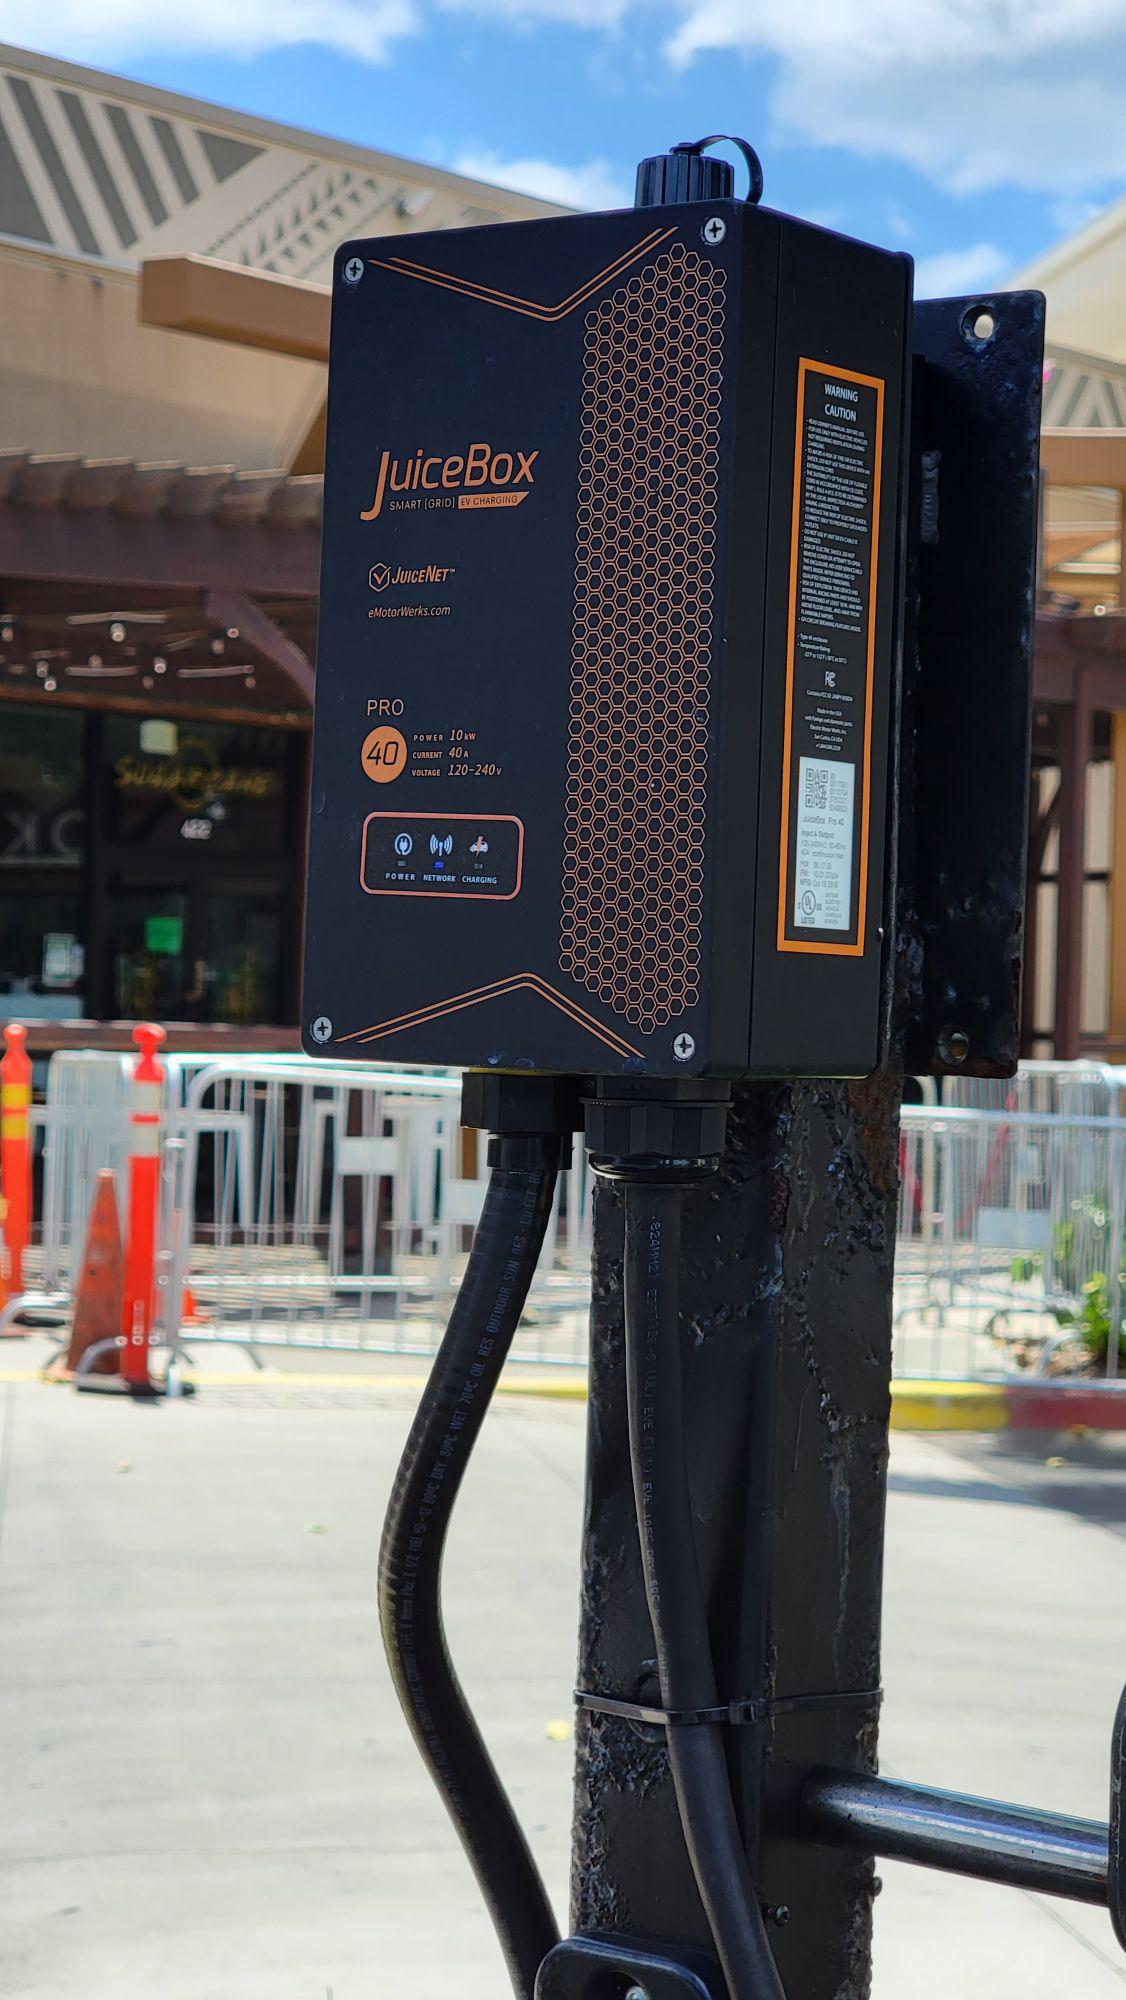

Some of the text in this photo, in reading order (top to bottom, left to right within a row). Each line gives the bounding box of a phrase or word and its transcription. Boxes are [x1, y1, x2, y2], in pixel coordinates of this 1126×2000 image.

[824, 383, 858, 403] WARNING
[824, 403, 857, 422] CAUTION
[389, 499, 422, 511] SMART
[461, 497, 471, 506] EV
[473, 495, 518, 505] CHARGING
[368, 604, 451, 619] eMotorWerks.com
[367, 698, 404, 717] PRO
[413, 733, 444, 742] POWER
[366, 740, 400, 766] 40
[412, 751, 443, 760] CURRENT
[411, 768, 441, 777] VOLTAGE
[385, 872, 498, 884] POWER NETWORK CHARGING
[511, 1235, 526, 1256] RES
[503, 1259, 519, 1281] SUN
[486, 1286, 512, 1333] OUTDOOR
[478, 1337, 494, 1357] RES
[470, 1362, 487, 1377] OIL
[450, 1407, 467, 1430] WET
